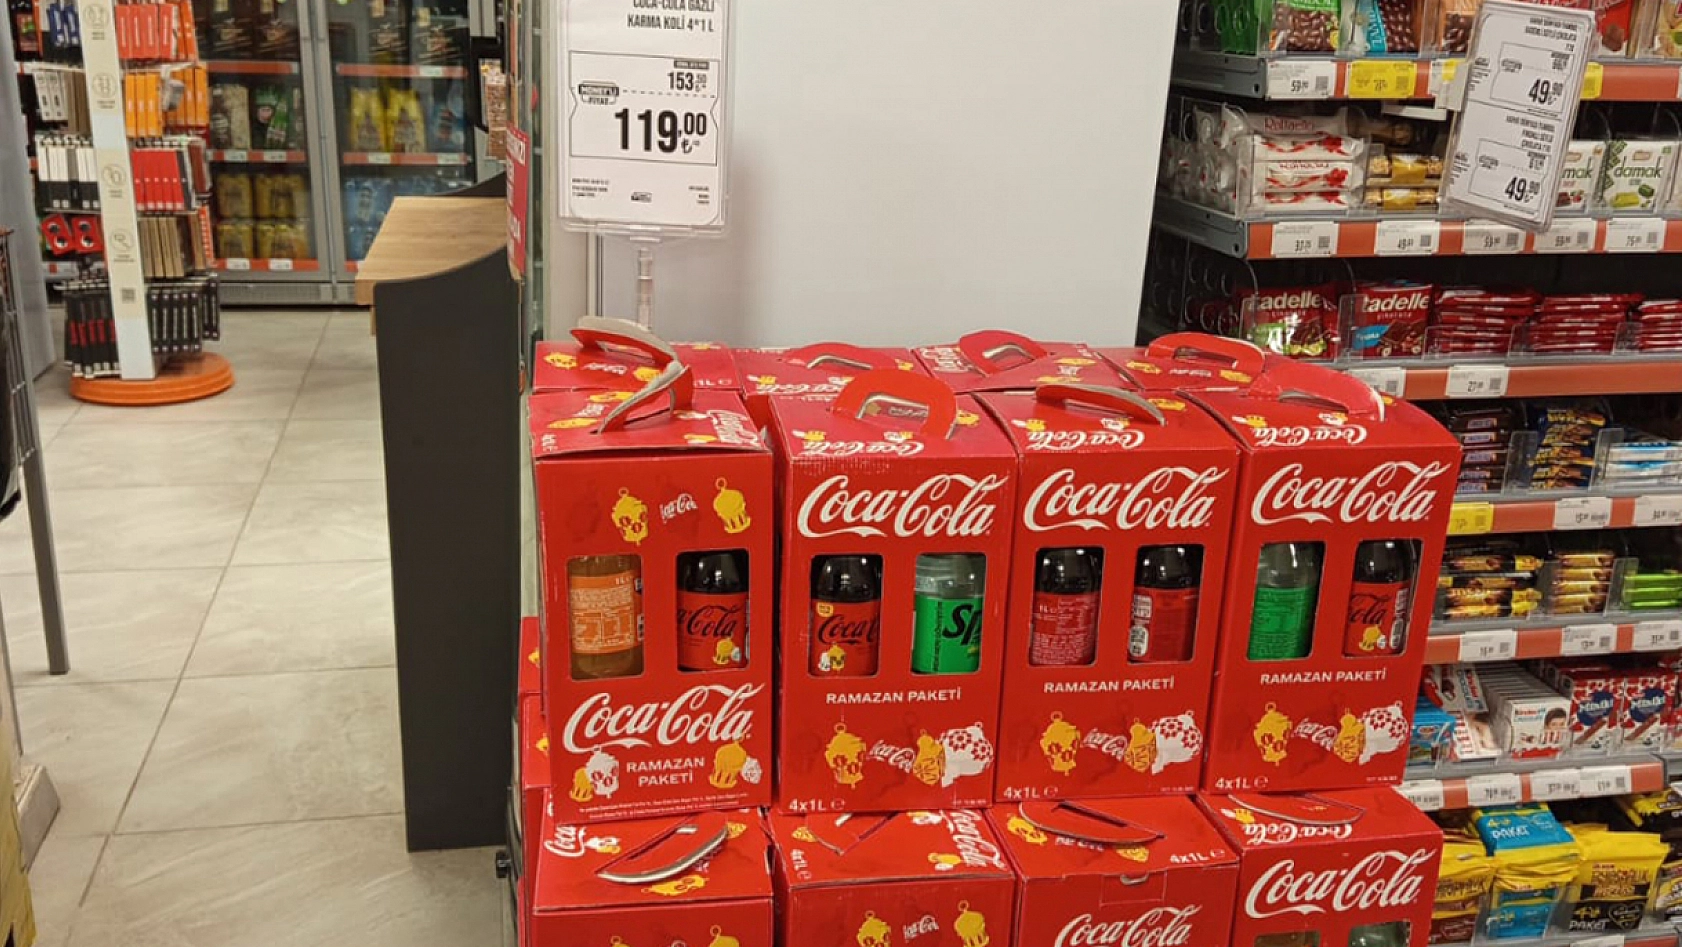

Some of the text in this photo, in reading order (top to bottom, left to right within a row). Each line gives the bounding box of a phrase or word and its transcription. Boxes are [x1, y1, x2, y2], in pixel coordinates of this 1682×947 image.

[1613, 156, 1663, 178] damak
[1028, 429, 1145, 450] Coca-Cola
[1253, 424, 1368, 447] Coca-Cola
[800, 441, 925, 456] Coca-Cola
[1023, 466, 1230, 531] Coca-Cola
[1251, 461, 1452, 526] Coca-Cola
[797, 474, 1009, 538] Coca-Cola
[1044, 675, 1174, 693] RAMAZAN PAKETİ
[1261, 667, 1387, 684] RAMAZAN PAKETİ
[826, 686, 961, 704] RAMAZAN PAKETİ
[563, 682, 766, 754] Coca-Cola
[626, 757, 705, 773] RAMAZAN
[638, 773, 693, 787] PAKETİ
[1215, 776, 1250, 789] 4x1L
[1003, 786, 1040, 798] 4x1L
[789, 799, 826, 811] 4x1L
[1245, 848, 1438, 919] Coca-Cola
[1054, 904, 1203, 947] Coca-Cola
